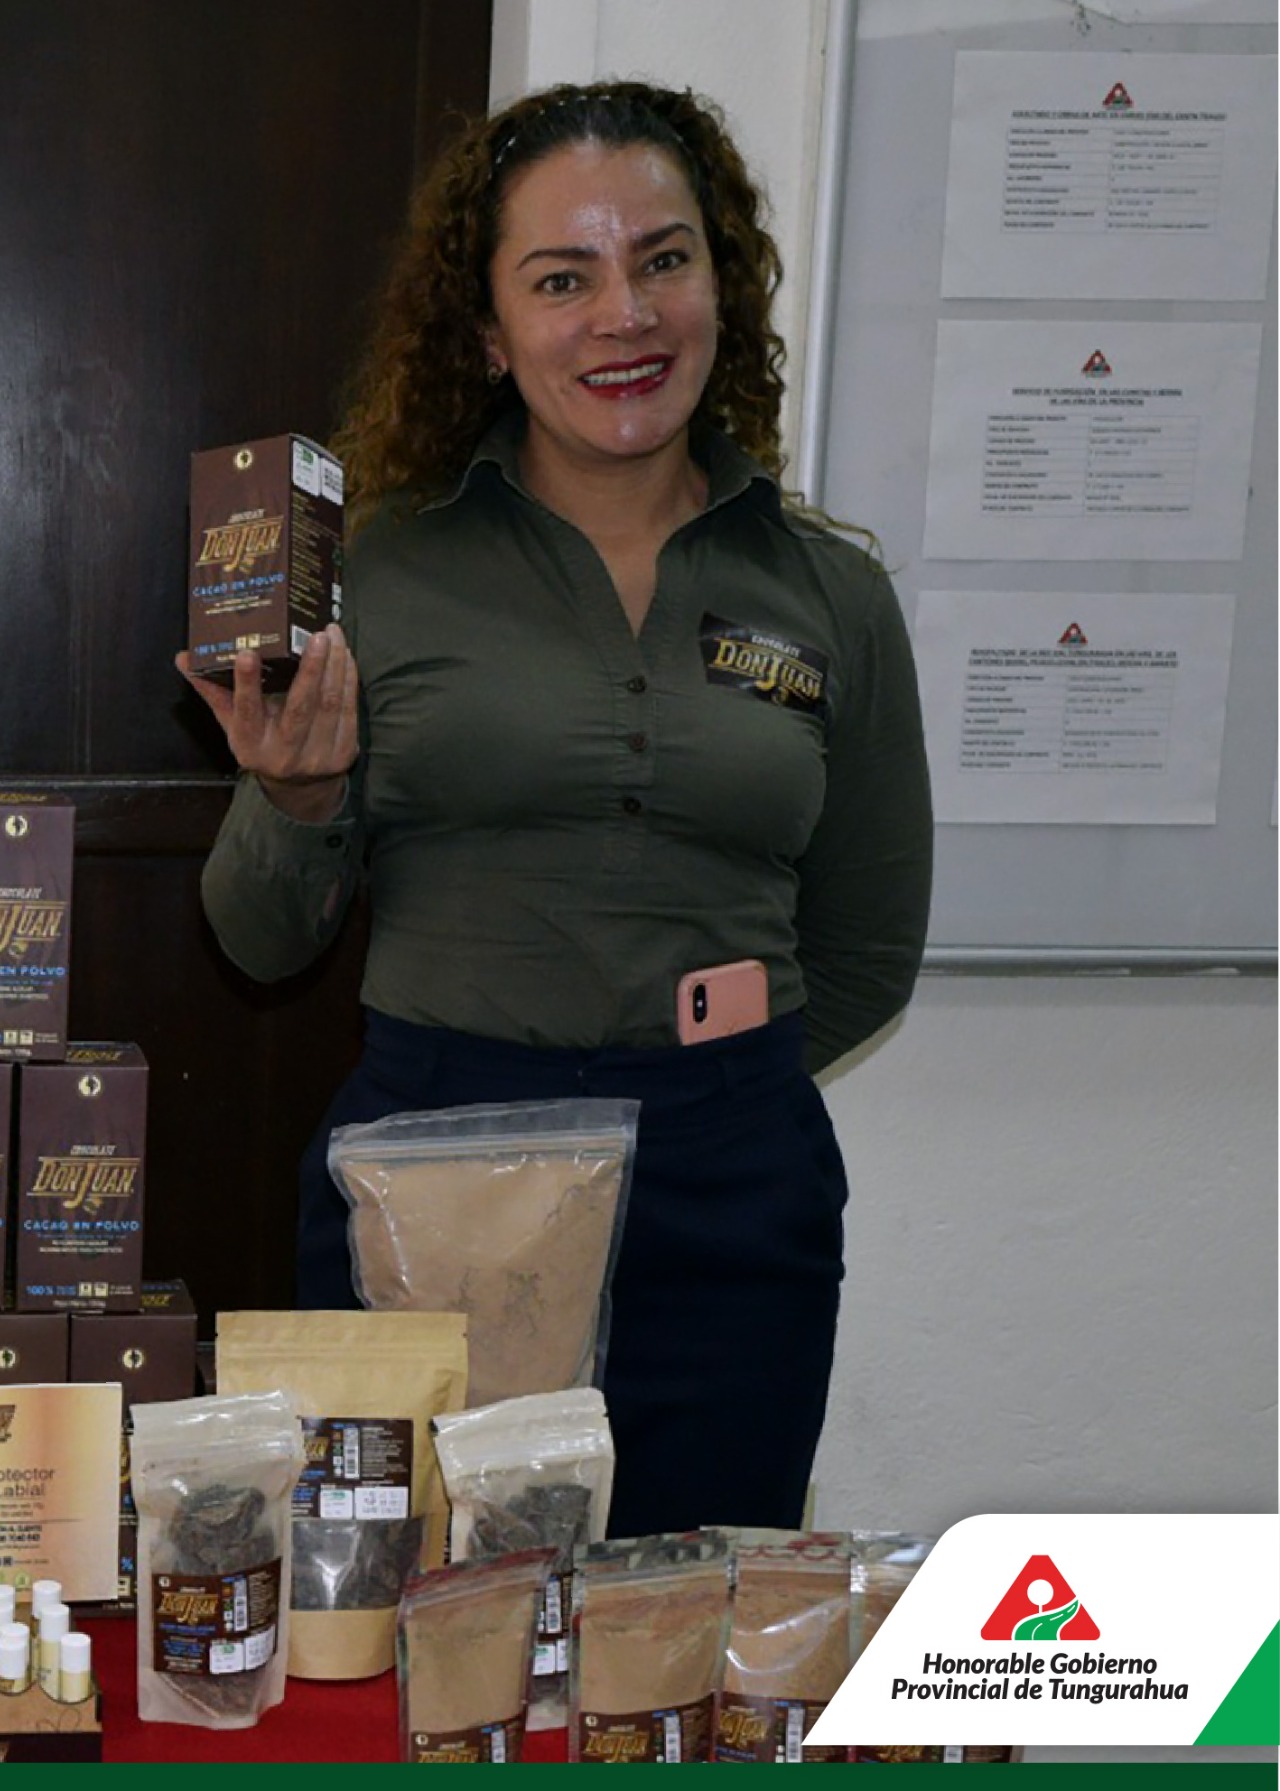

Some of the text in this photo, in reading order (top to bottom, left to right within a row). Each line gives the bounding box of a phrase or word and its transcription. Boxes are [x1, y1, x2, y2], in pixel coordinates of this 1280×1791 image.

[192, 572, 285, 597] CACAO EN POLVO
[713, 639, 821, 700] DON JUAN
[0, 965, 16, 976] EN
[20, 965, 65, 977] POLVO
[32, 1159, 136, 1209] DON JUAN
[23, 1219, 140, 1231] CACAO EN POLVO
